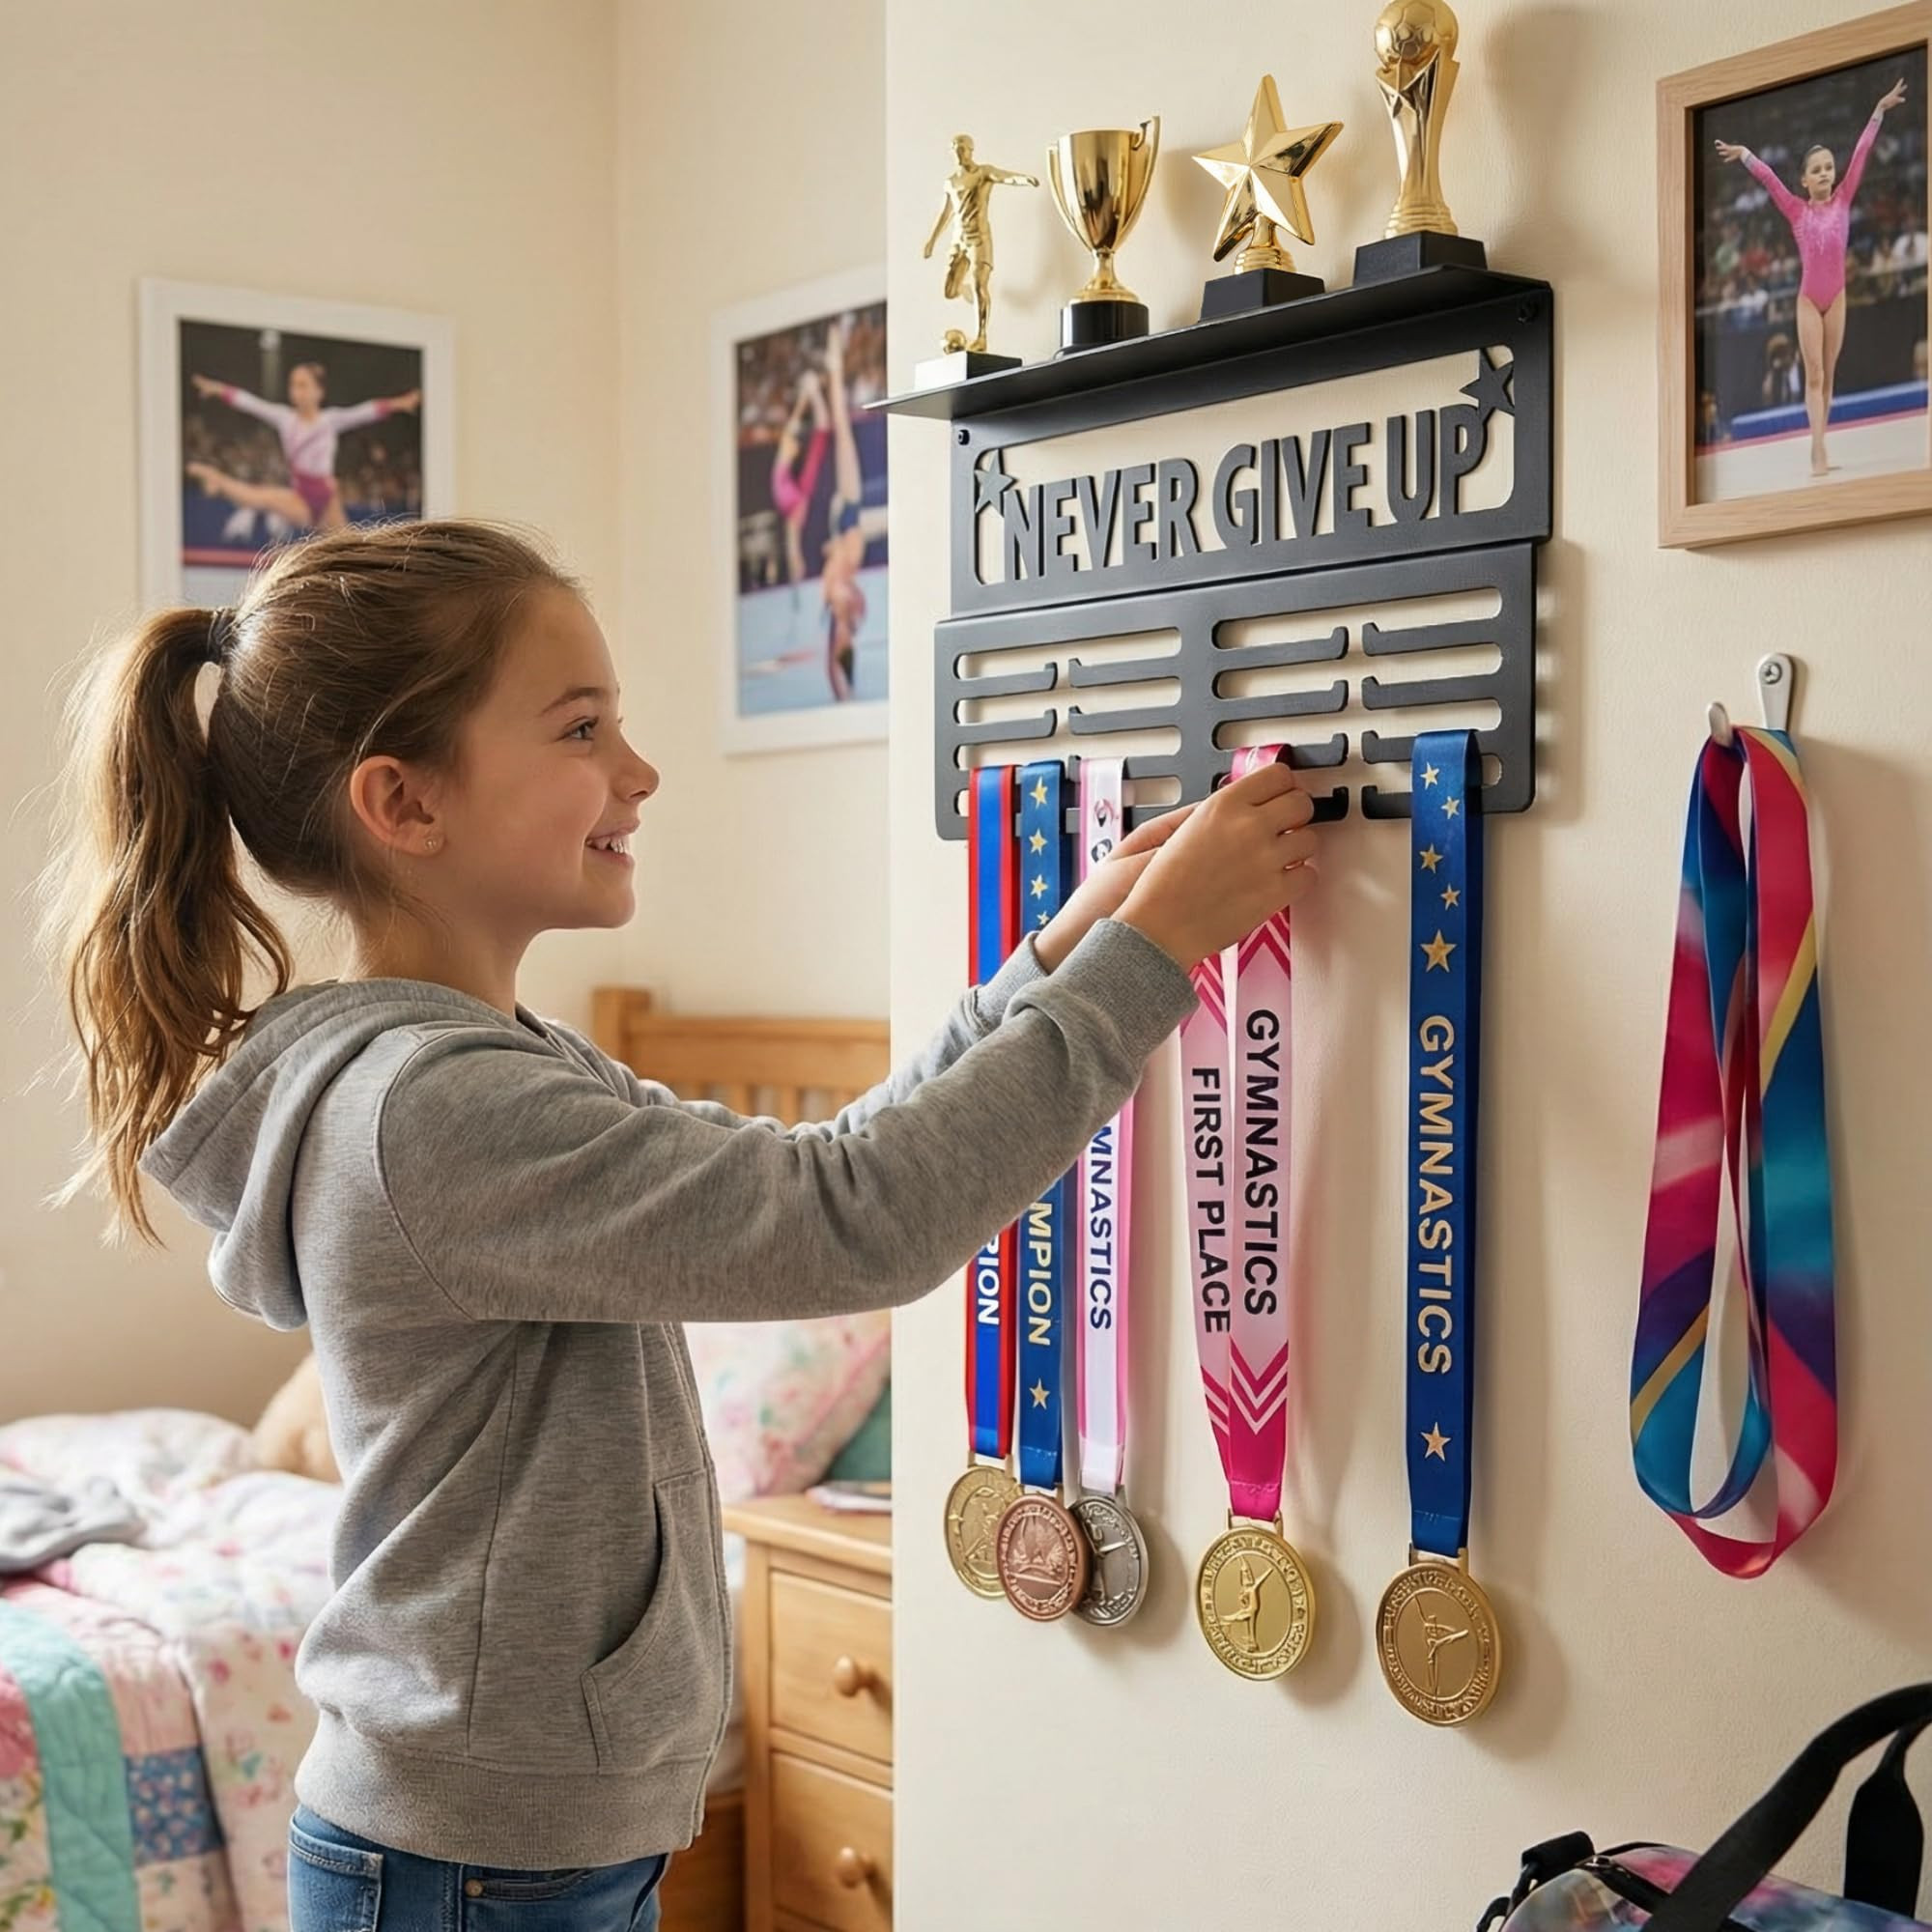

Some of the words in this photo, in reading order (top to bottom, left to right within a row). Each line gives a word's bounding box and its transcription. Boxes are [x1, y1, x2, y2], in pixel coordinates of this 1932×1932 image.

[1003, 458, 1203, 580] NEVER
[1213, 421, 1373, 547] GIVE
[1386, 404, 1489, 522] UP
[1192, 1066, 1224, 1187] FIRST
[1243, 1009, 1280, 1316] GYMNASTICS
[1417, 1015, 1456, 1376] GYMNASTICS
[1197, 1200, 1231, 1334] PLACE
